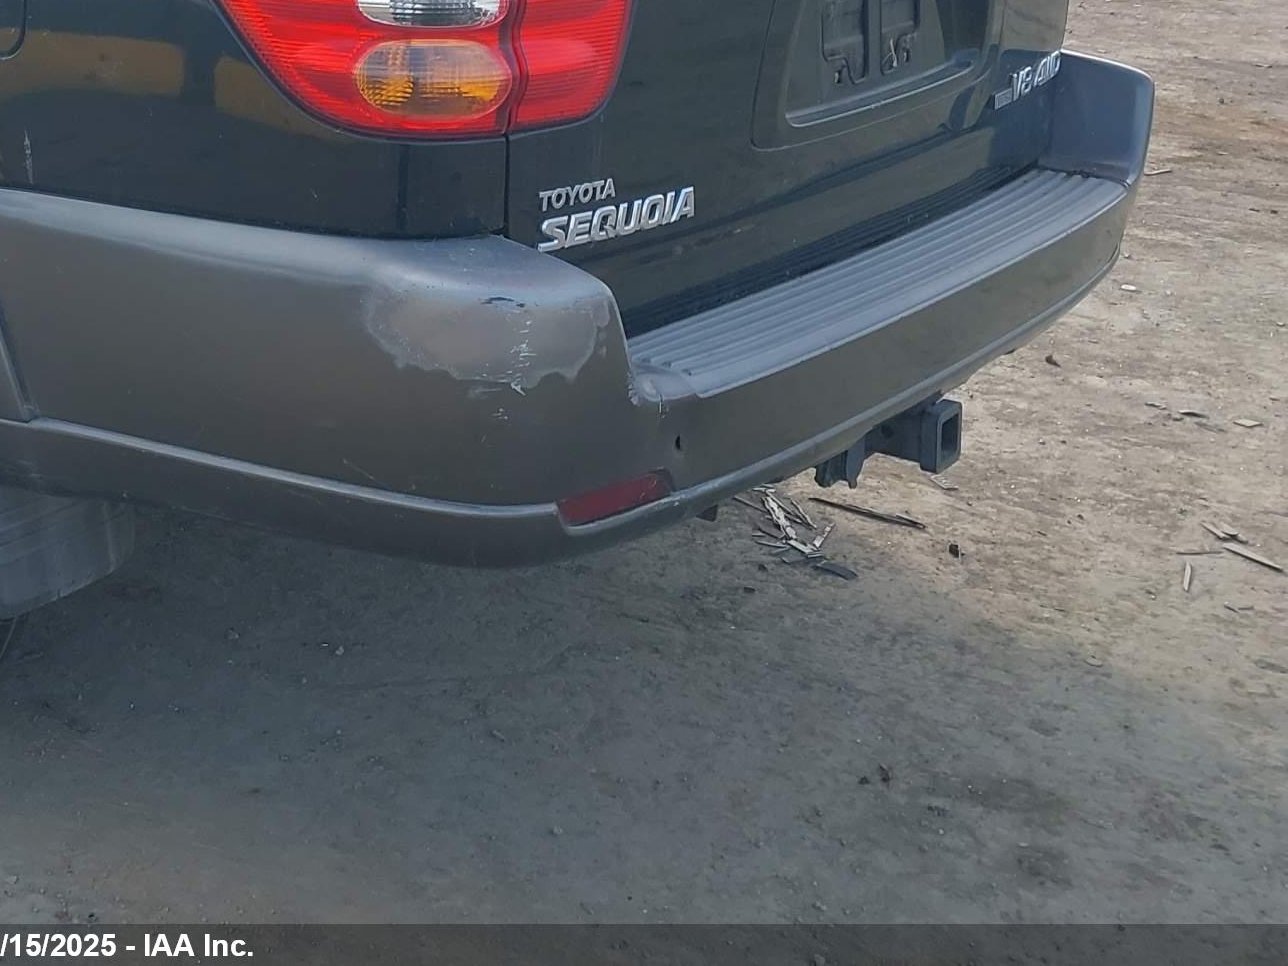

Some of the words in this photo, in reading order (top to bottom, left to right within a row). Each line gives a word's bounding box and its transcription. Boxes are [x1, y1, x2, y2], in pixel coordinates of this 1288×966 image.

[1012, 66, 1033, 102] V8
[539, 178, 616, 212] TOYOTA
[537, 186, 696, 253] SEQUOIA
